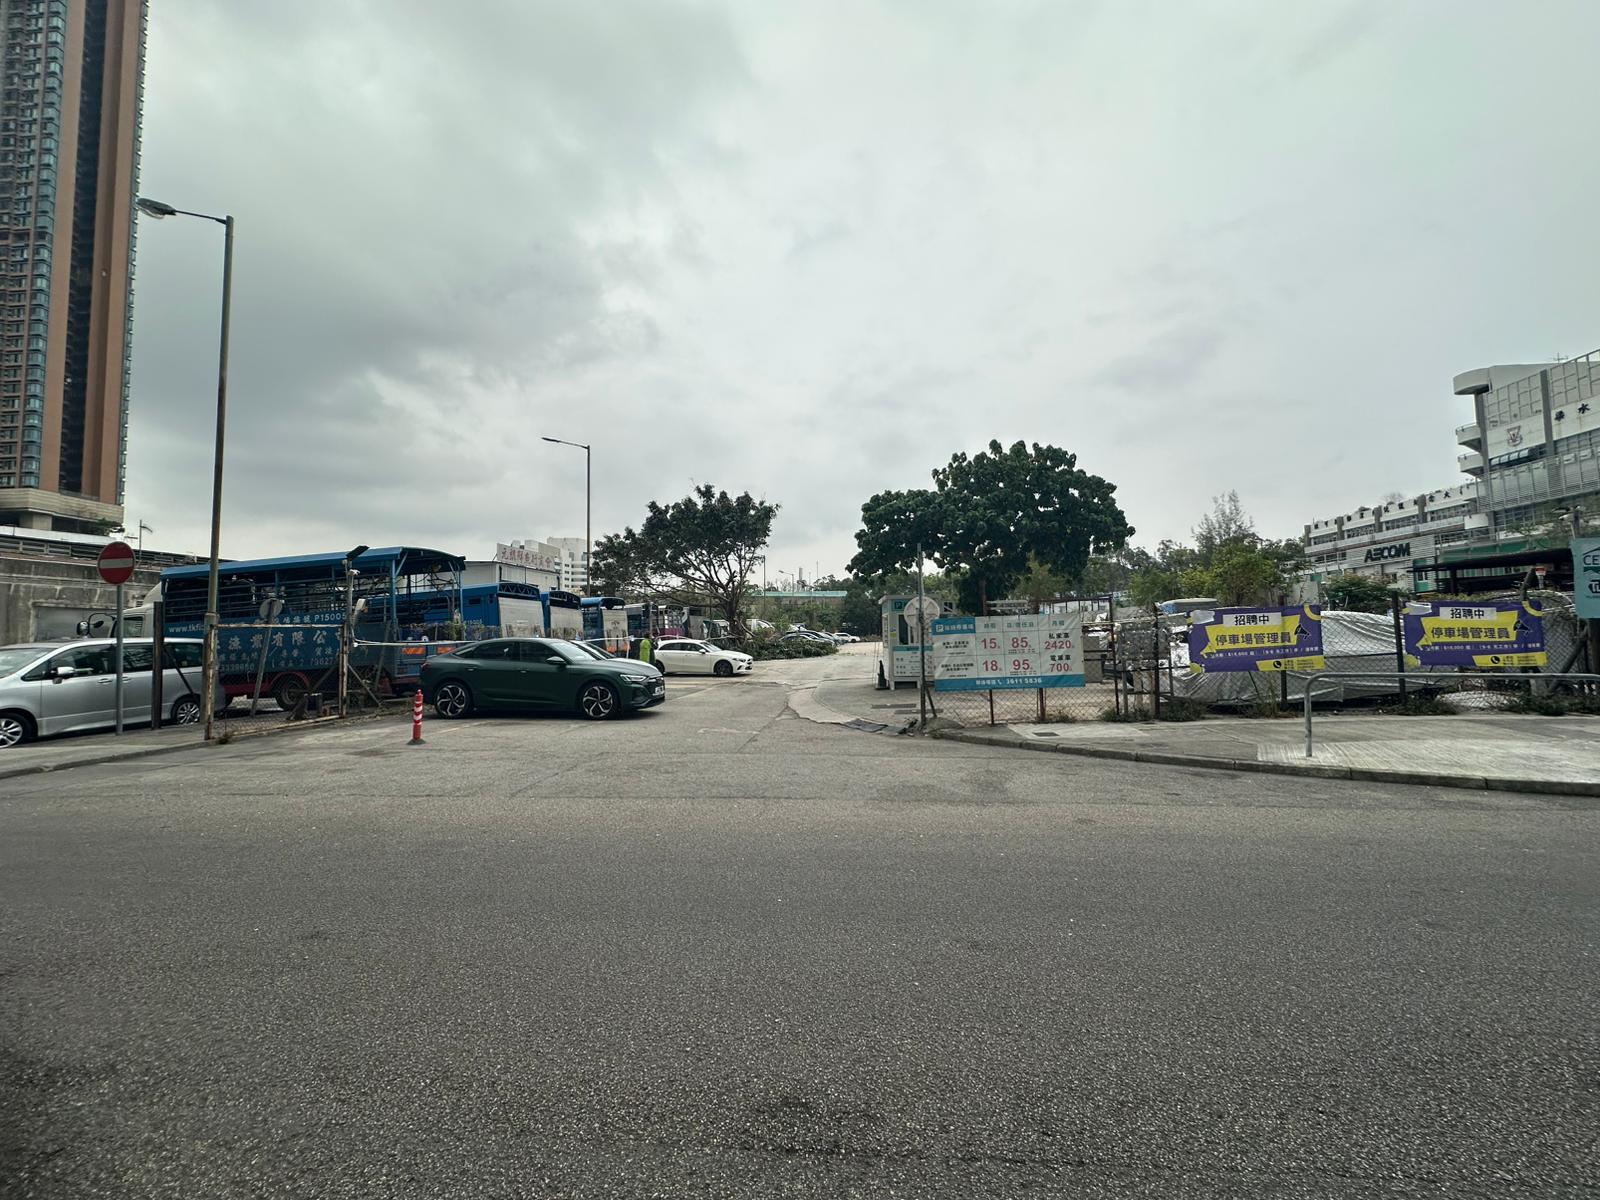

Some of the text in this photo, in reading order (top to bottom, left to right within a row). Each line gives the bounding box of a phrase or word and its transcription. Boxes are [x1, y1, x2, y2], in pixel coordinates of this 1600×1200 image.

[1364, 542, 1410, 562] AECOM
[314, 612, 347, 623] P15005
[1450, 608, 1485, 619] 招聘中
[1234, 614, 1269, 626] 招聘中
[1215, 631, 1292, 646] 停車場管理員
[1431, 626, 1510, 639] 停車場管理員
[981, 637, 997, 649] 15
[1011, 636, 1029, 649] 85
[1044, 640, 1072, 650] 2420
[982, 659, 999, 672] 18
[1012, 659, 1030, 671] 95
[1049, 663, 1070, 672] 700
